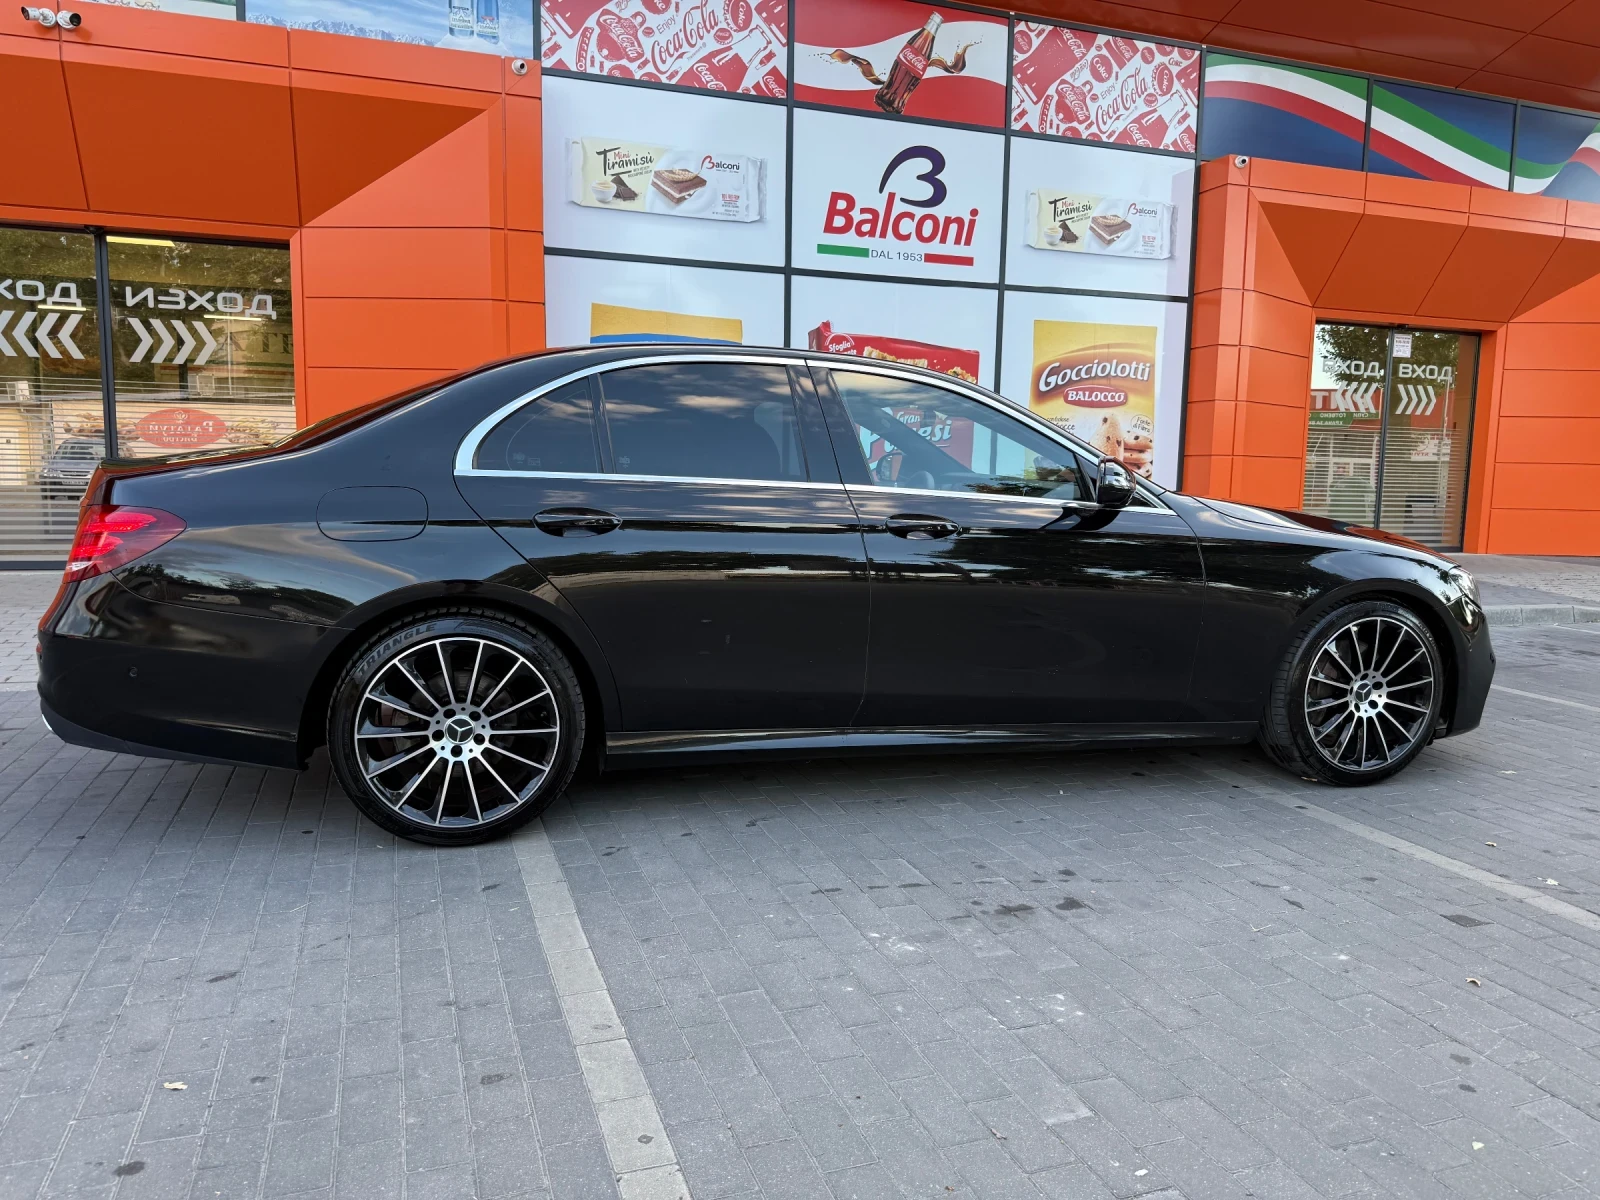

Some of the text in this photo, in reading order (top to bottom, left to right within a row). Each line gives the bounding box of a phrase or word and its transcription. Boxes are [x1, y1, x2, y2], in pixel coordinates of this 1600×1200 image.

[656, 15, 676, 34] Enjoy
[738, 2, 748, 27] Coke
[651, 0, 719, 75] Coca-Cola
[902, 48, 927, 70] Coca-Cola
[1093, 57, 1109, 79] Coke
[1096, 63, 1148, 135] Coca-Cola
[1101, 83, 1116, 100] Enjoy
[596, 147, 654, 176] Tiramisù
[613, 151, 631, 160] Mini
[701, 155, 740, 170] Balconi
[1048, 197, 1092, 222] Tiramisù
[1061, 200, 1075, 208] Mini
[1127, 203, 1157, 216] Balconi
[823, 191, 979, 246] Balconi
[871, 249, 923, 262] DAL 1953
[126, 286, 277, 320] ИЗХОД
[828, 341, 851, 353] Sfoglia
[1038, 359, 1151, 392] Gocciolotti
[1322, 359, 1381, 379] ВХОД
[1398, 363, 1453, 382] ВХОД
[1067, 391, 1125, 403] BALOCCO
[896, 411, 921, 424] Gran
[357, 623, 438, 675] TRIANGLE
